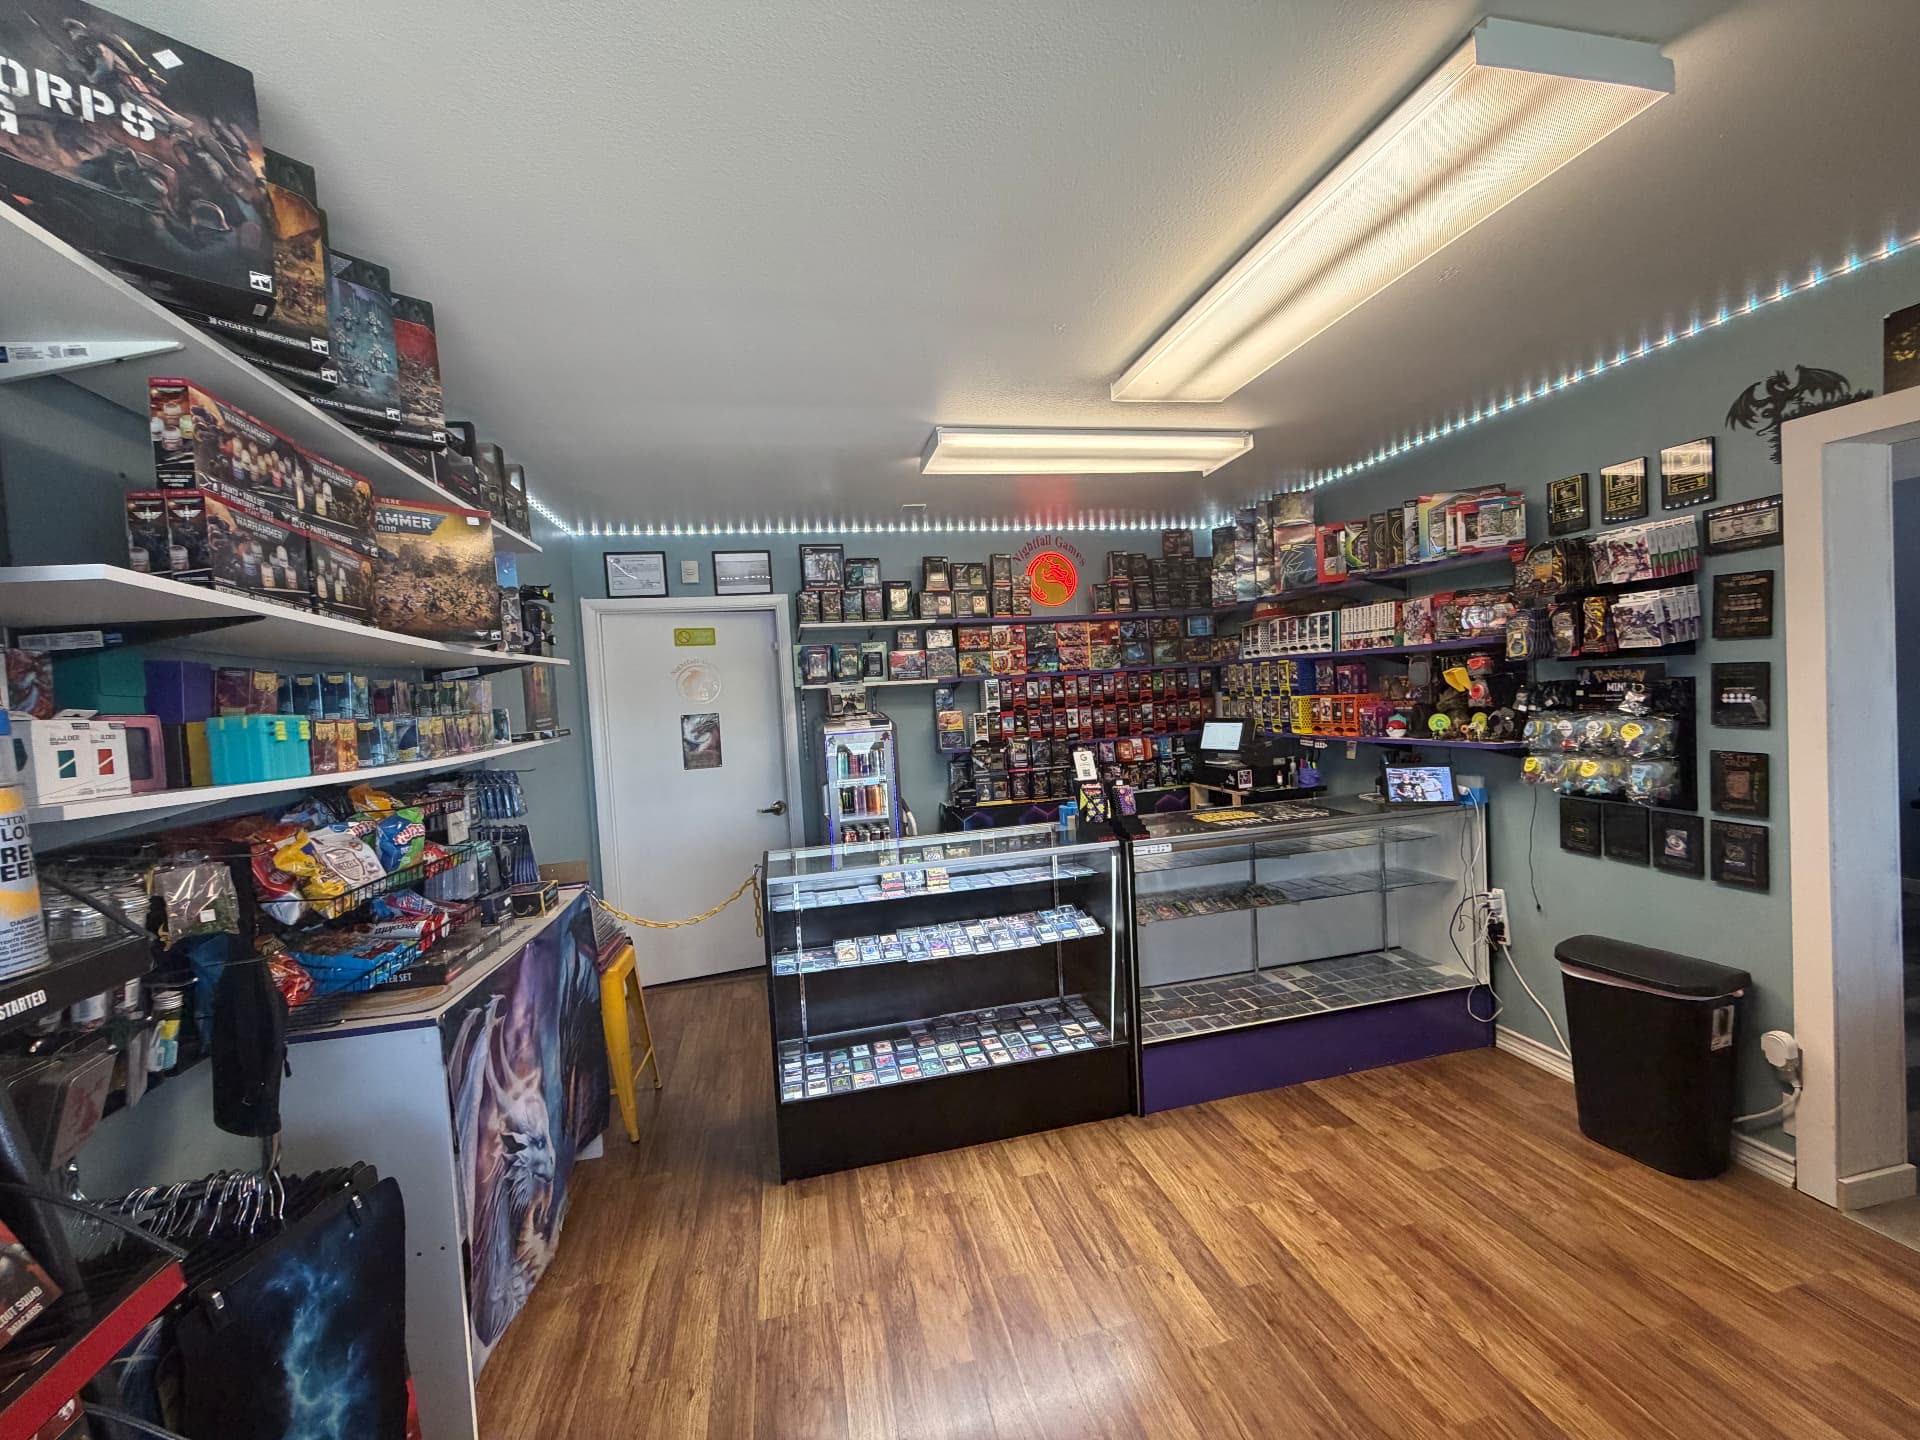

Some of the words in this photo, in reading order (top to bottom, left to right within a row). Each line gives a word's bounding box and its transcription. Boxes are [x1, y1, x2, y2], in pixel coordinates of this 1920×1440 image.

[235, 515, 285, 541] WARHAMMER
[1012, 534, 1052, 564] Nightfall
[1055, 535, 1087, 568] Games
[0, 989, 48, 1021] STARTED
[17, 1285, 43, 1312] SQUAD
